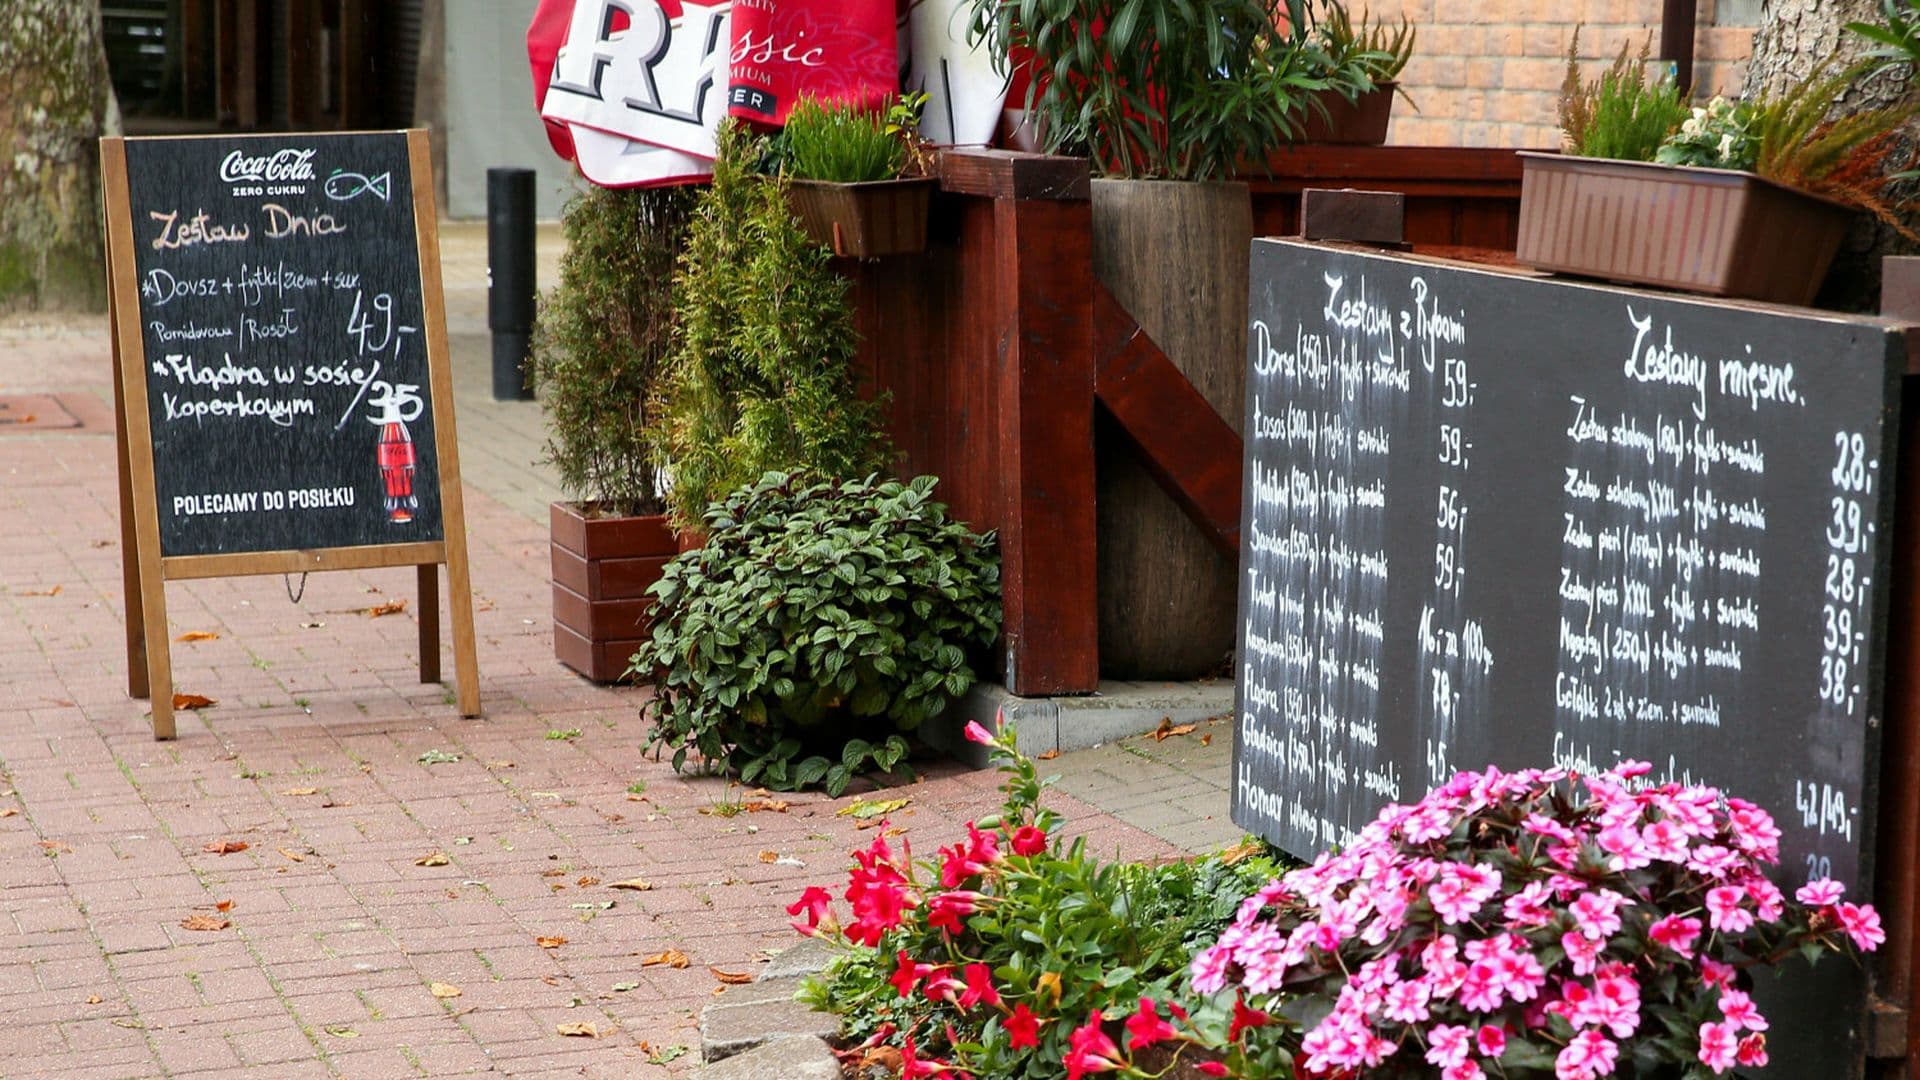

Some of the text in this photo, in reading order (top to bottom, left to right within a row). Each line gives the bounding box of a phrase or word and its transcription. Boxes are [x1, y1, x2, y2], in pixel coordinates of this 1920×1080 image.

[728, 88, 764, 108] ER
[232, 184, 306, 197] ZERO CUKRU
[150, 203, 347, 250] Zestaw Dnia
[1324, 271, 1465, 373] Zestawy z Rybami
[274, 364, 296, 384] w
[1624, 304, 1707, 421] Zestawy
[173, 486, 355, 516] POLECAMY DO POSIŁKU
[1445, 630, 1459, 657] za
[1239, 761, 1283, 822] Homar
